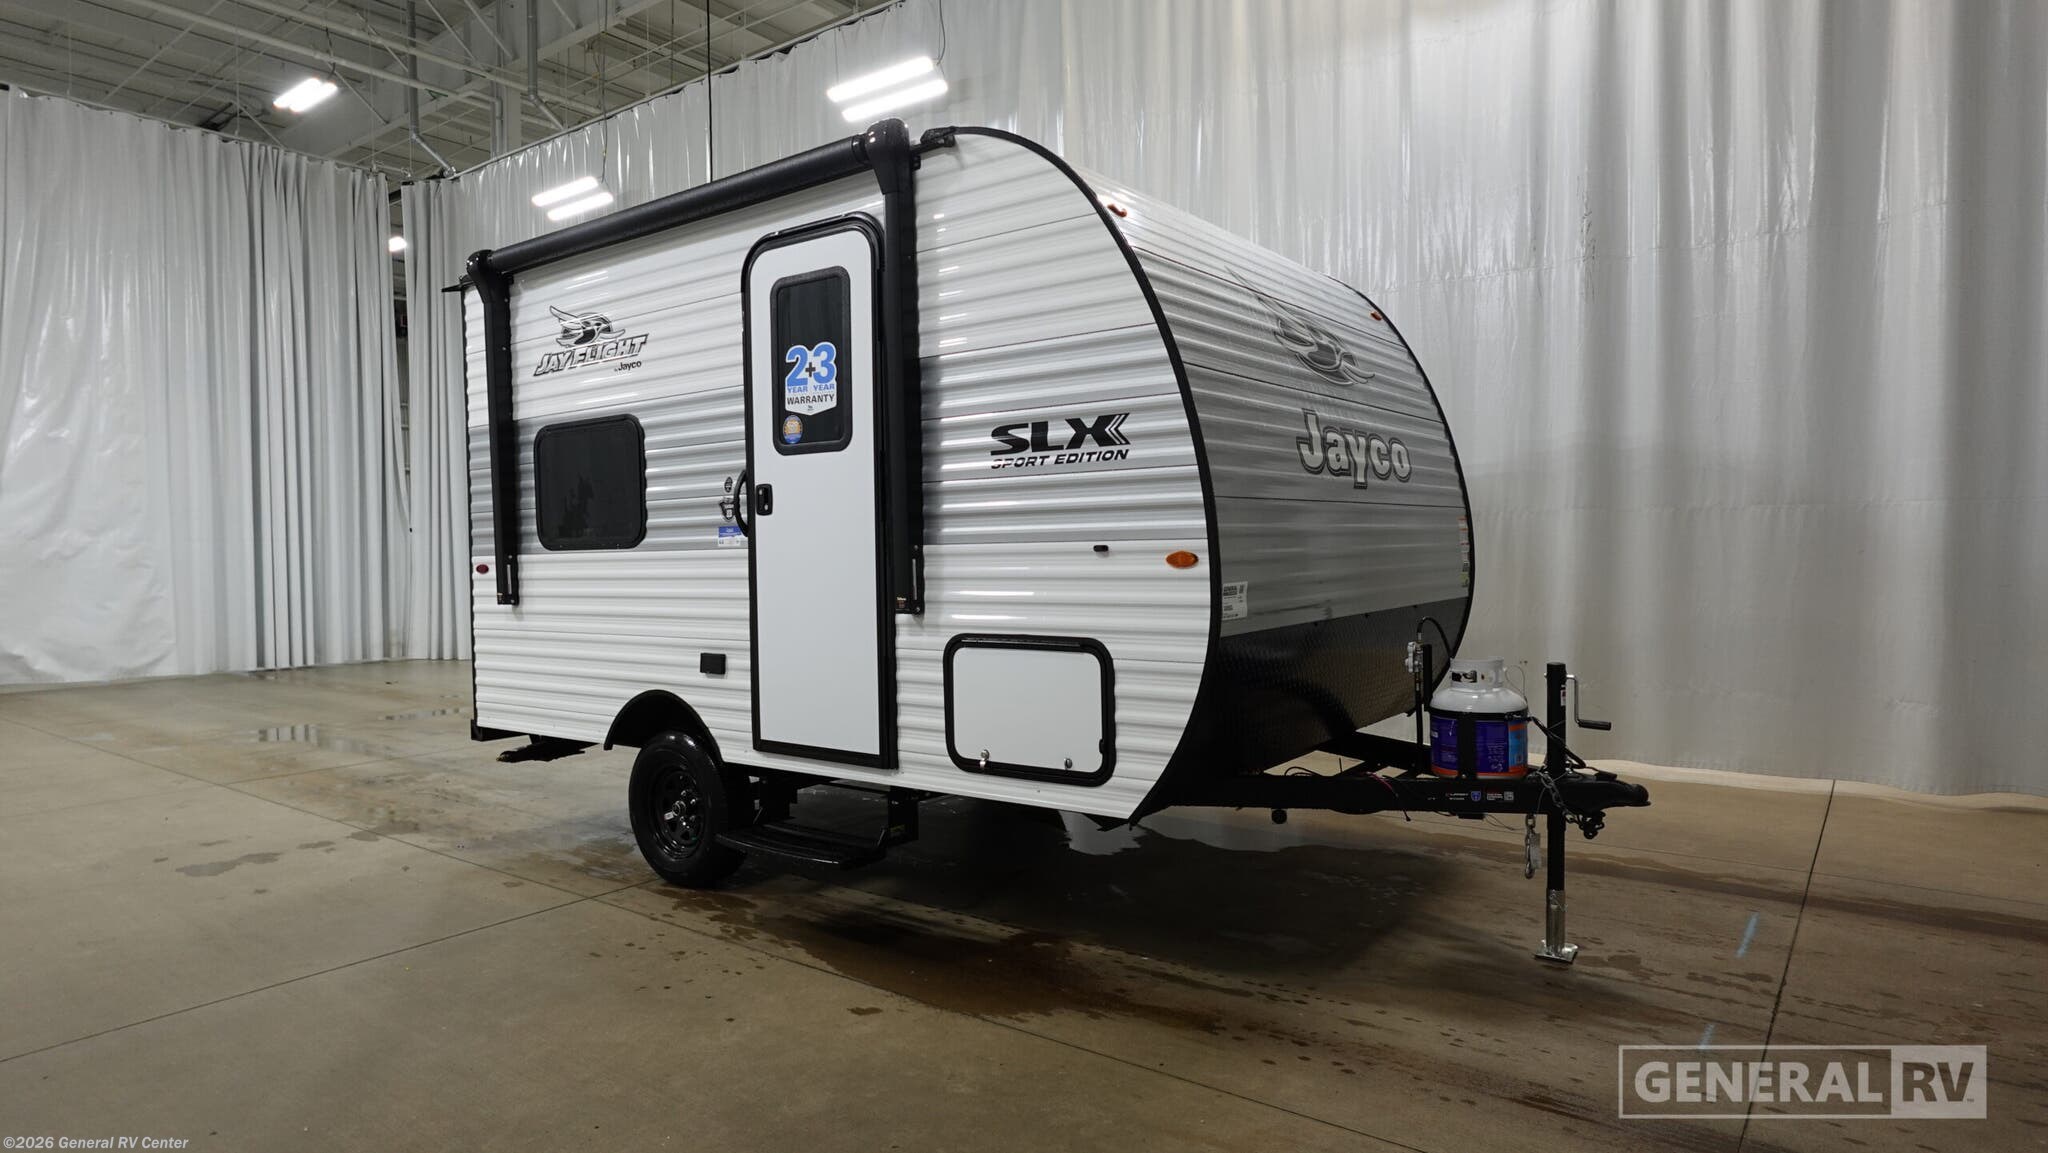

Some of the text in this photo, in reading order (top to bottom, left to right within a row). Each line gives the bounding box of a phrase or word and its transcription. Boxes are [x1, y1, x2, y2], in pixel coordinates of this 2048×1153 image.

[533, 333, 649, 376] JAY FLIGHT
[618, 361, 642, 372] Jayco
[787, 383, 835, 394] YEAR YEAR
[787, 393, 835, 405] WARRANTY
[990, 412, 1130, 456] SLX
[1296, 408, 1412, 489] Jayco
[991, 449, 1130, 470] SPORT EDITION
